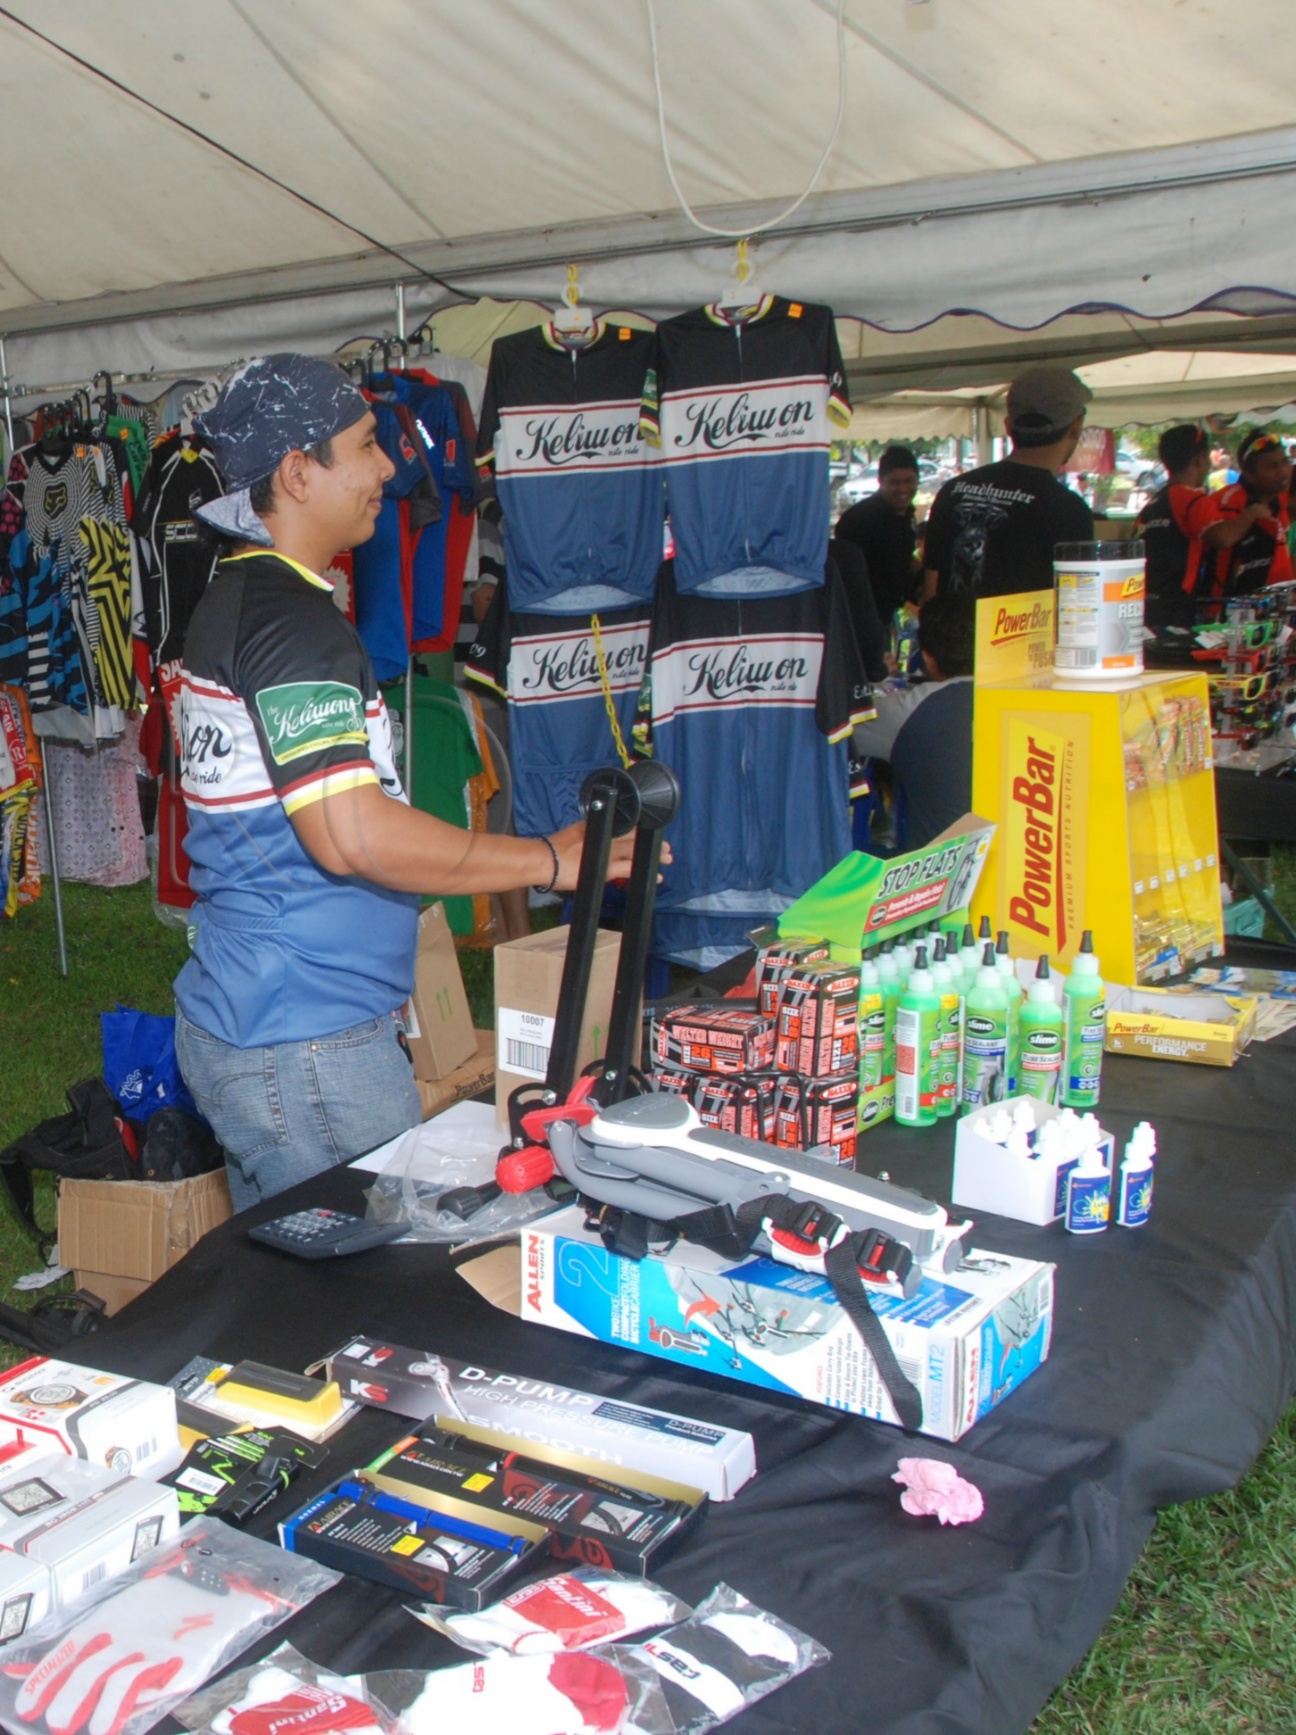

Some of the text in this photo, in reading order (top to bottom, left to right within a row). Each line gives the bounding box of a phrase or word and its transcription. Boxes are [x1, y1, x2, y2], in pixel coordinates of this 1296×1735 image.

[954, 480, 1036, 504] Headhunter
[995, 602, 1052, 636] PowerBar
[1008, 735, 1056, 938] PowerBar
[876, 843, 964, 899] STOP FLATS
[521, 1014, 545, 1027] 10007
[968, 1019, 993, 1031] slime
[1113, 1022, 1160, 1034] PowerBar
[1030, 1033, 1058, 1045] slime
[1134, 1034, 1207, 1052] PERFORMANCE
[526, 1234, 542, 1313] ALLEN
[362, 1347, 394, 1368] KS
[350, 1379, 388, 1403] KS
[458, 1366, 597, 1406] D-PUMP
[462, 1384, 518, 1409] HIGH
[542, 1573, 609, 1620] Santini
